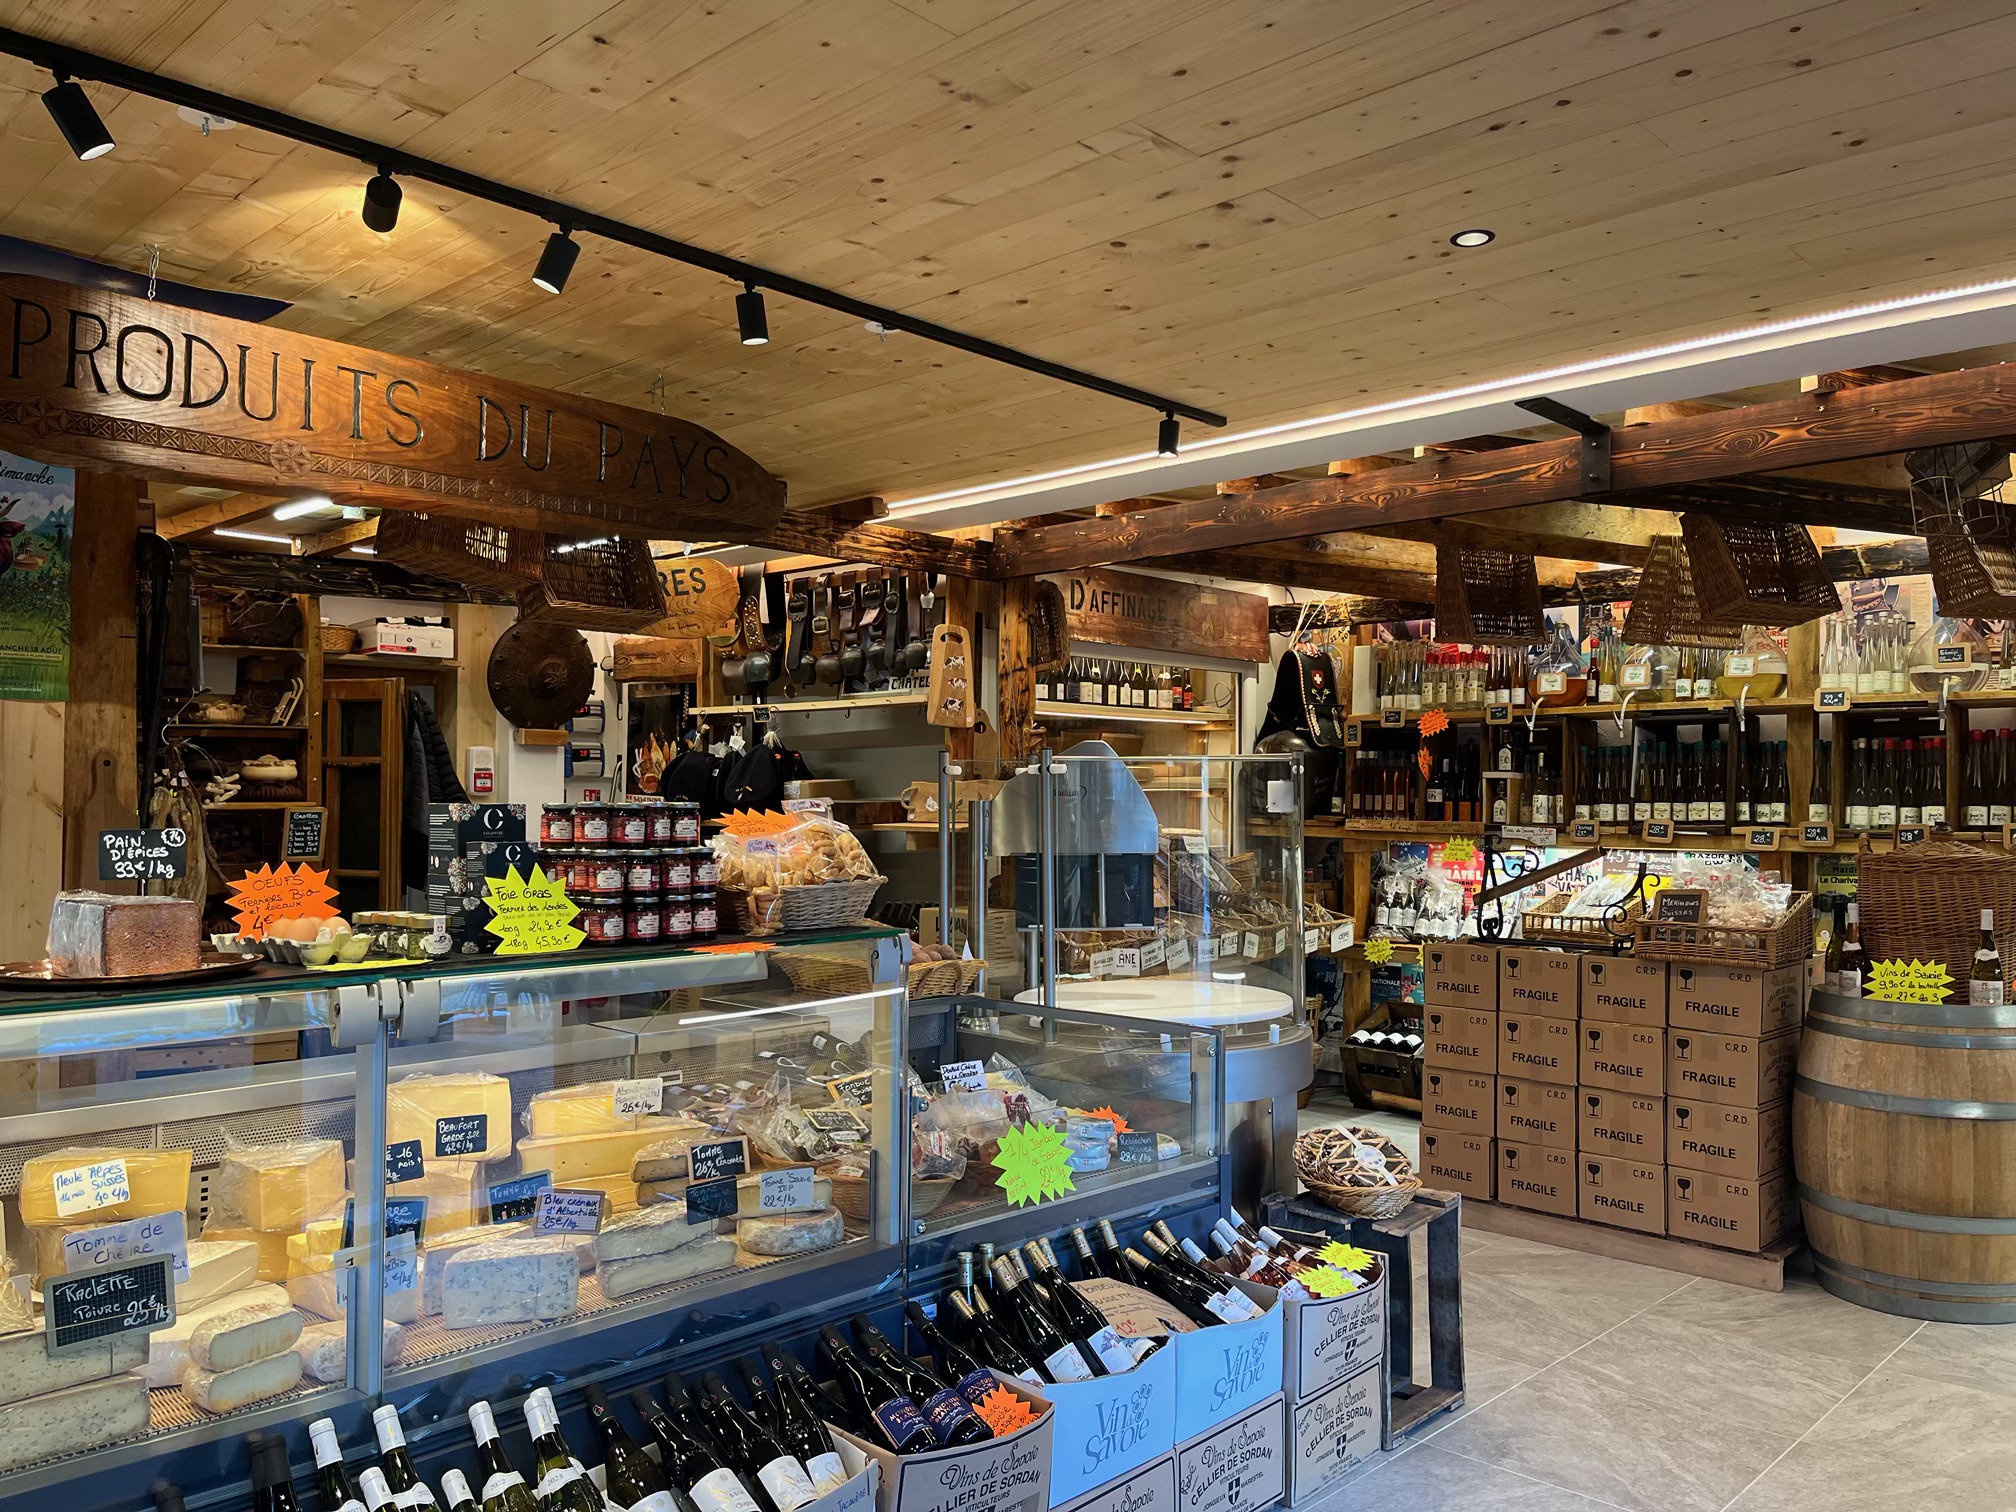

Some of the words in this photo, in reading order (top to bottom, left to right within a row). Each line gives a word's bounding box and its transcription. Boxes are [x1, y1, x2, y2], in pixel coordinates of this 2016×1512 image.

[11, 299, 425, 448] PRODUITS
[476, 395, 554, 473] DU
[597, 419, 732, 503] PAYS
[252, 875, 304, 890] OEUFS
[494, 886, 518, 901] Foie
[523, 888, 552, 898] Gras
[1880, 970, 1898, 978] Vins
[1900, 969, 1910, 977] de
[1437, 982, 1479, 994] FRAGILE
[1513, 988, 1558, 1002] FRAGILE
[1597, 995, 1646, 1009] FRAGILE
[1931, 993, 1939, 1002] 3
[1685, 1001, 1739, 1017] FRAGILE
[1436, 1043, 1479, 1057] FRAGILE
[1512, 1052, 1558, 1067] FRAGILE
[1594, 1061, 1643, 1077] FRAGILE
[1682, 1070, 1736, 1088] FRAGILE
[1435, 1105, 1478, 1120] FRAGILE
[1511, 1116, 1557, 1132] FRAGILE
[1594, 1128, 1643, 1145] FRAGILE
[1682, 1140, 1736, 1159] FRAGILE
[1431, 1166, 1472, 1182] FRAGILE
[1511, 1180, 1557, 1196] FRAGILE
[1594, 1195, 1644, 1213] FRAGILE
[1684, 1211, 1738, 1231] FRAGILE
[140, 1223, 164, 1239] de
[1314, 1325, 1347, 1357] CELLIER
[1349, 1319, 1359, 1332] DE
[1095, 1398, 1128, 1438] Vin
[1305, 1421, 1334, 1458] CELLIER
[1336, 1413, 1345, 1427] DE
[1346, 1406, 1373, 1421] SORDAN
[1082, 1419, 1149, 1476] Savoie
[940, 1464, 979, 1490] Vins
[982, 1460, 998, 1481] de
[1191, 1464, 1225, 1506] CELLIER
[1227, 1455, 1238, 1471] DE
[1240, 1447, 1272, 1463] SORDAN
[979, 1481, 996, 1497] DE
[1000, 1470, 1041, 1490] SORDAN
